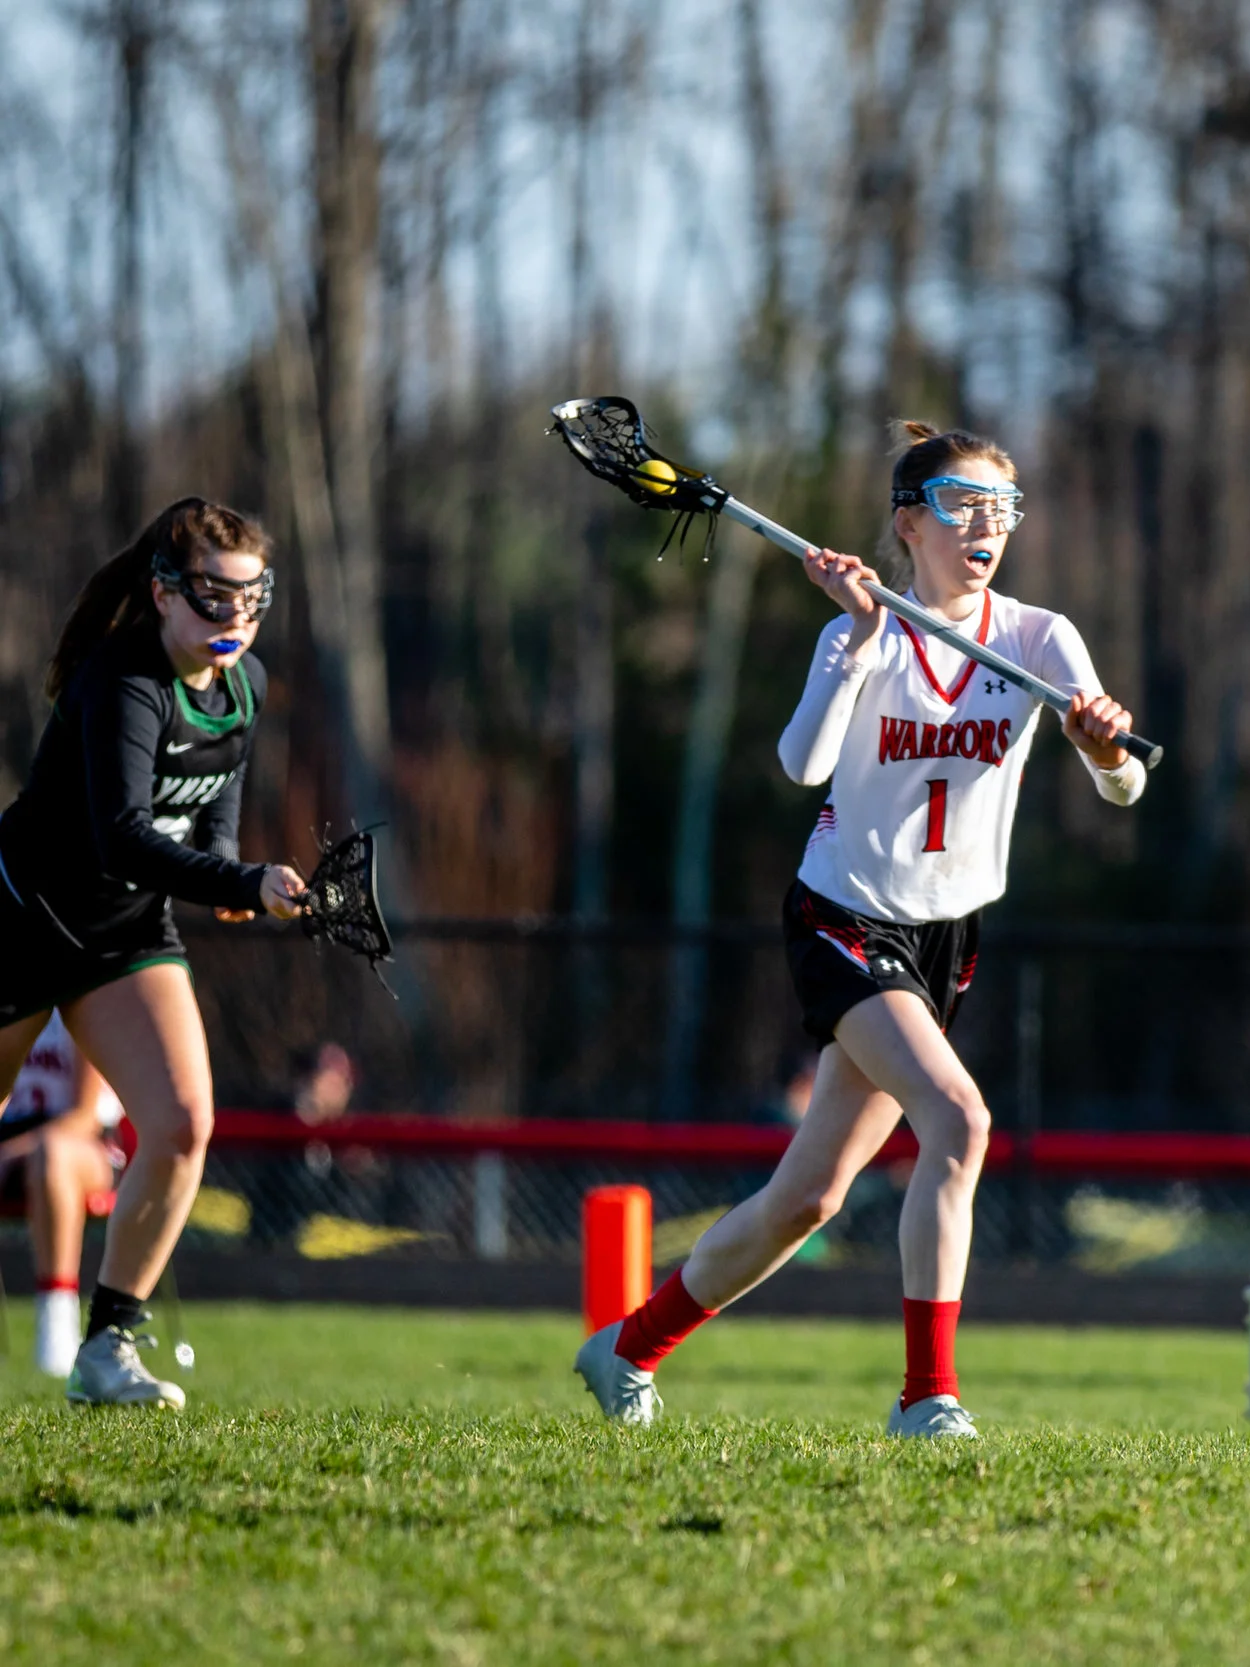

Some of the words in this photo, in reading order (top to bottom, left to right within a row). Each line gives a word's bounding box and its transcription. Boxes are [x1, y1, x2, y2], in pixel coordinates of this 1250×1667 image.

[897, 490, 917, 501] STX
[878, 715, 1012, 768] WARRIORS
[921, 778, 949, 853] 1
